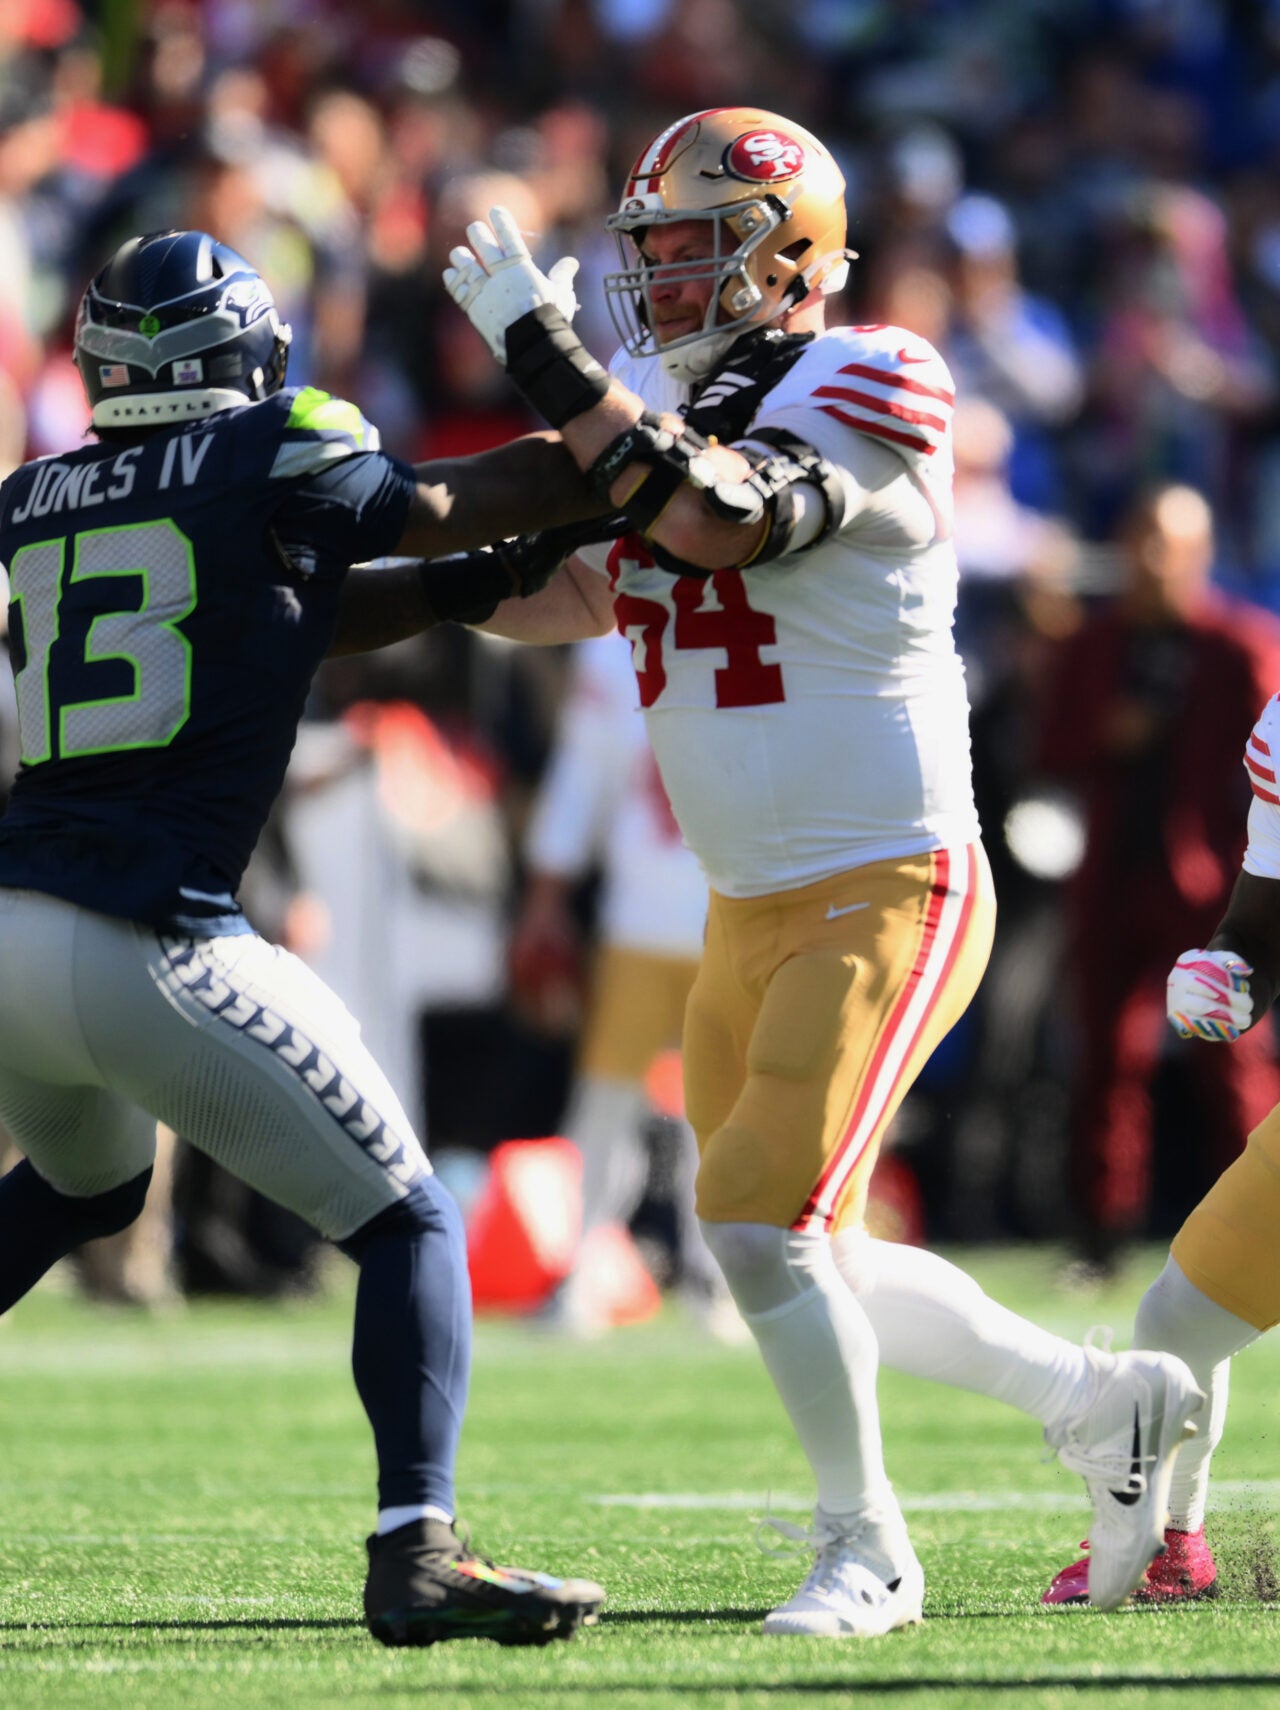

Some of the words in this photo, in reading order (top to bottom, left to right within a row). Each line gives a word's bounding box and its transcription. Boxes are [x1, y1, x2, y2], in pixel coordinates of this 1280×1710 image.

[112, 401, 212, 418] SEATTLE
[11, 445, 145, 525] JONES
[157, 433, 216, 490] IV
[9, 517, 198, 767] 13
[605, 533, 787, 710] 64
